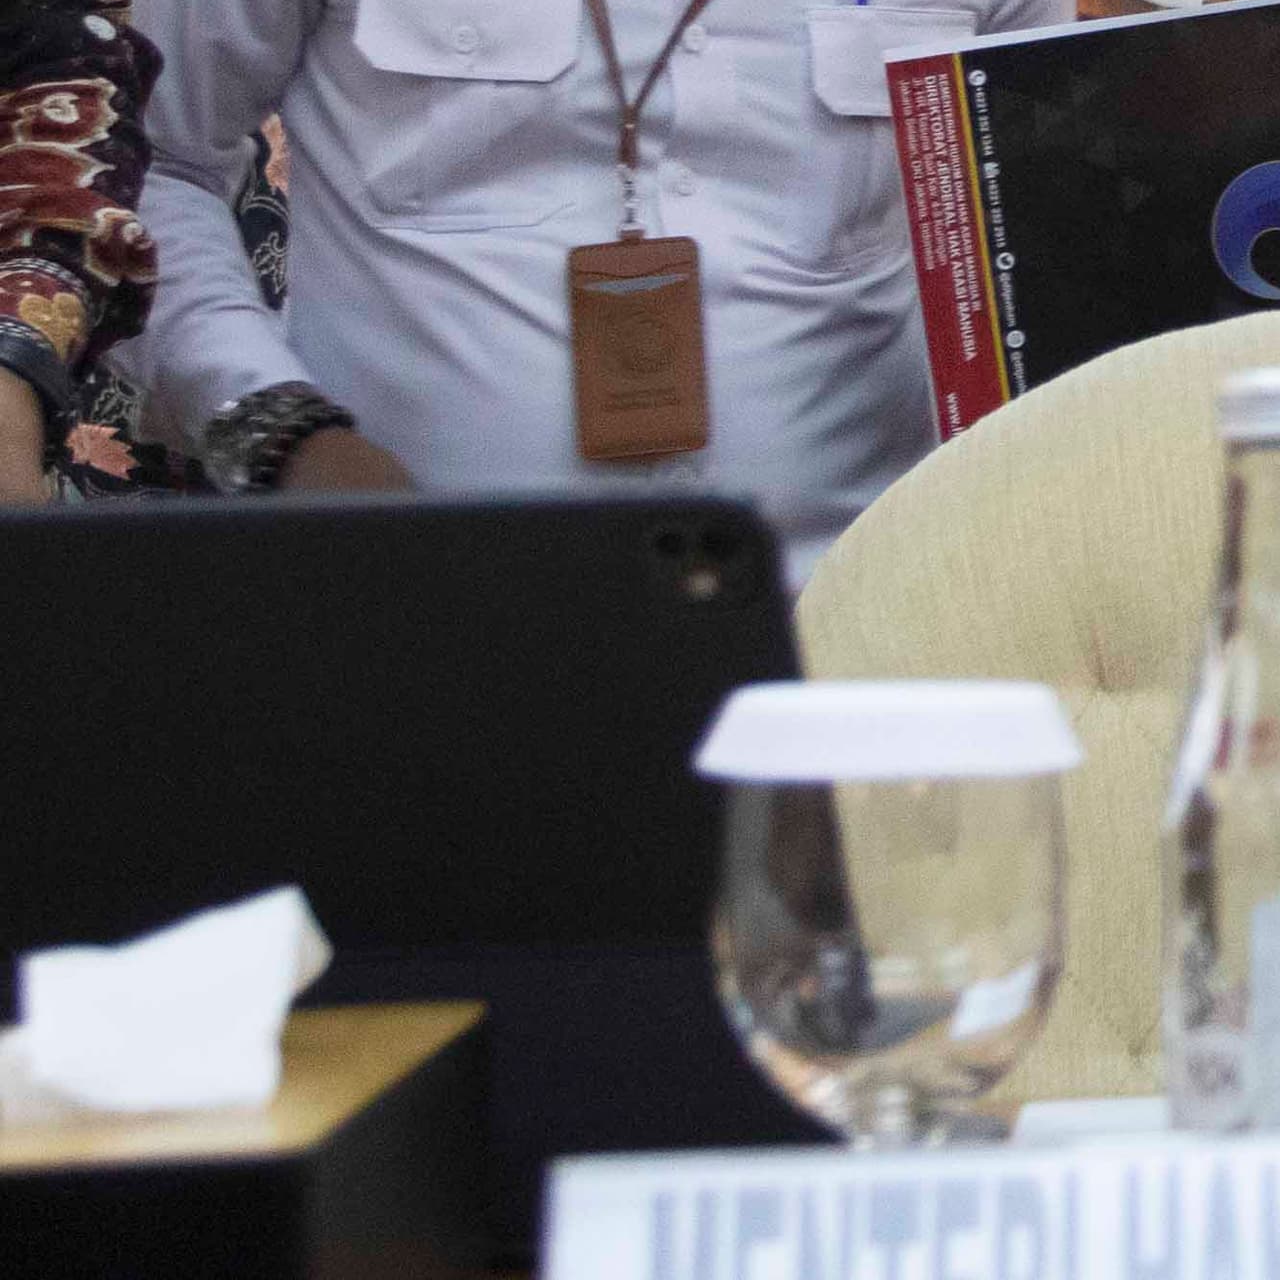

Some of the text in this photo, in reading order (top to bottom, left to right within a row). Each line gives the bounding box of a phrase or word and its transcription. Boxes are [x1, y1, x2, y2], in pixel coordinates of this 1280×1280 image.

[938, 73, 956, 142] KEMENTERIAN
[948, 145, 962, 178] HUKUM
[953, 180, 966, 201] DAN
[923, 75, 977, 361] DIREKTORAT JENDERAL HAK ASASI MANUSIA
[956, 202, 969, 223] HAK
[959, 225, 974, 254] ASASI
[964, 255, 980, 300] MANUSIA
